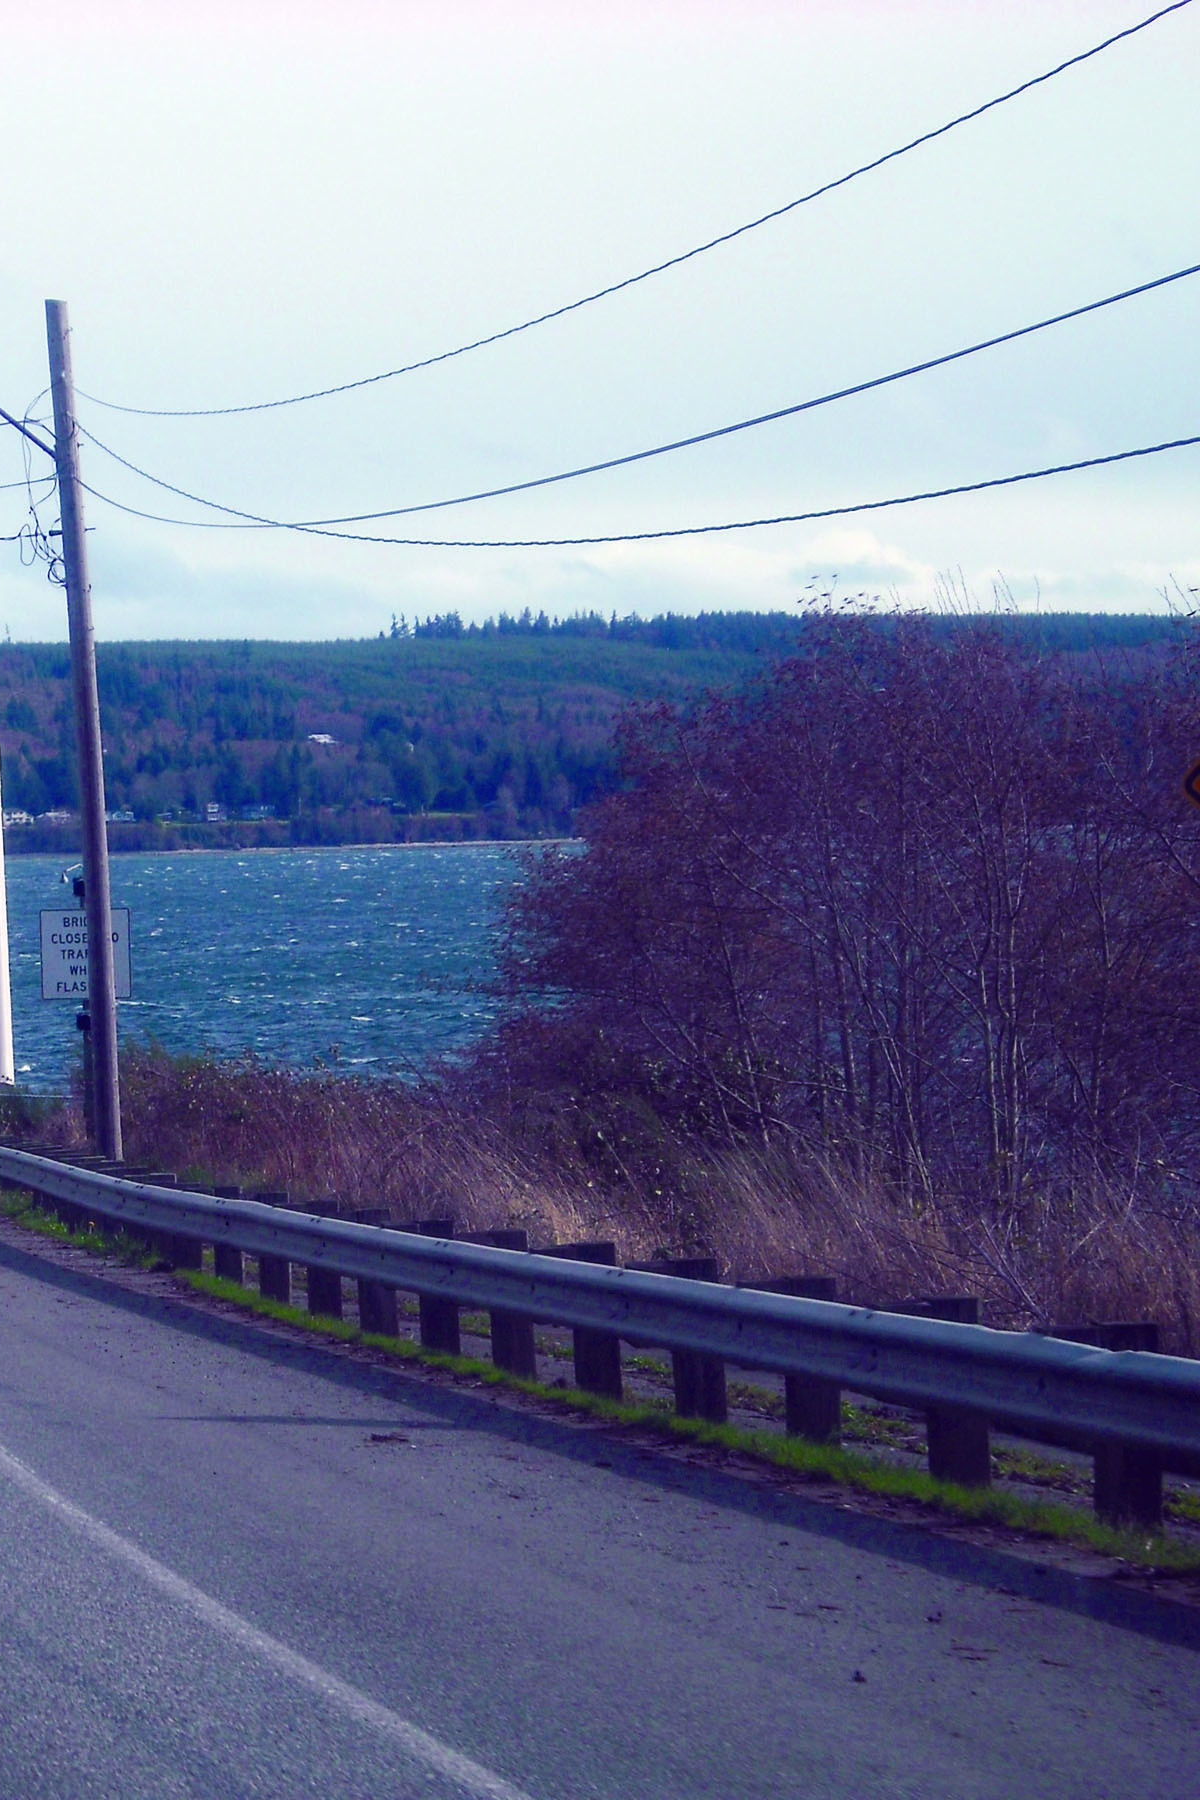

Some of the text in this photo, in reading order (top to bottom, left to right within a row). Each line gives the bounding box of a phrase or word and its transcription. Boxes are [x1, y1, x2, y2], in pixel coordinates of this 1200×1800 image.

[63, 916, 88, 928] BRID
[51, 932, 119, 945] CLOSE O
[69, 965, 87, 976] WH
[56, 982, 87, 993] FLAS
